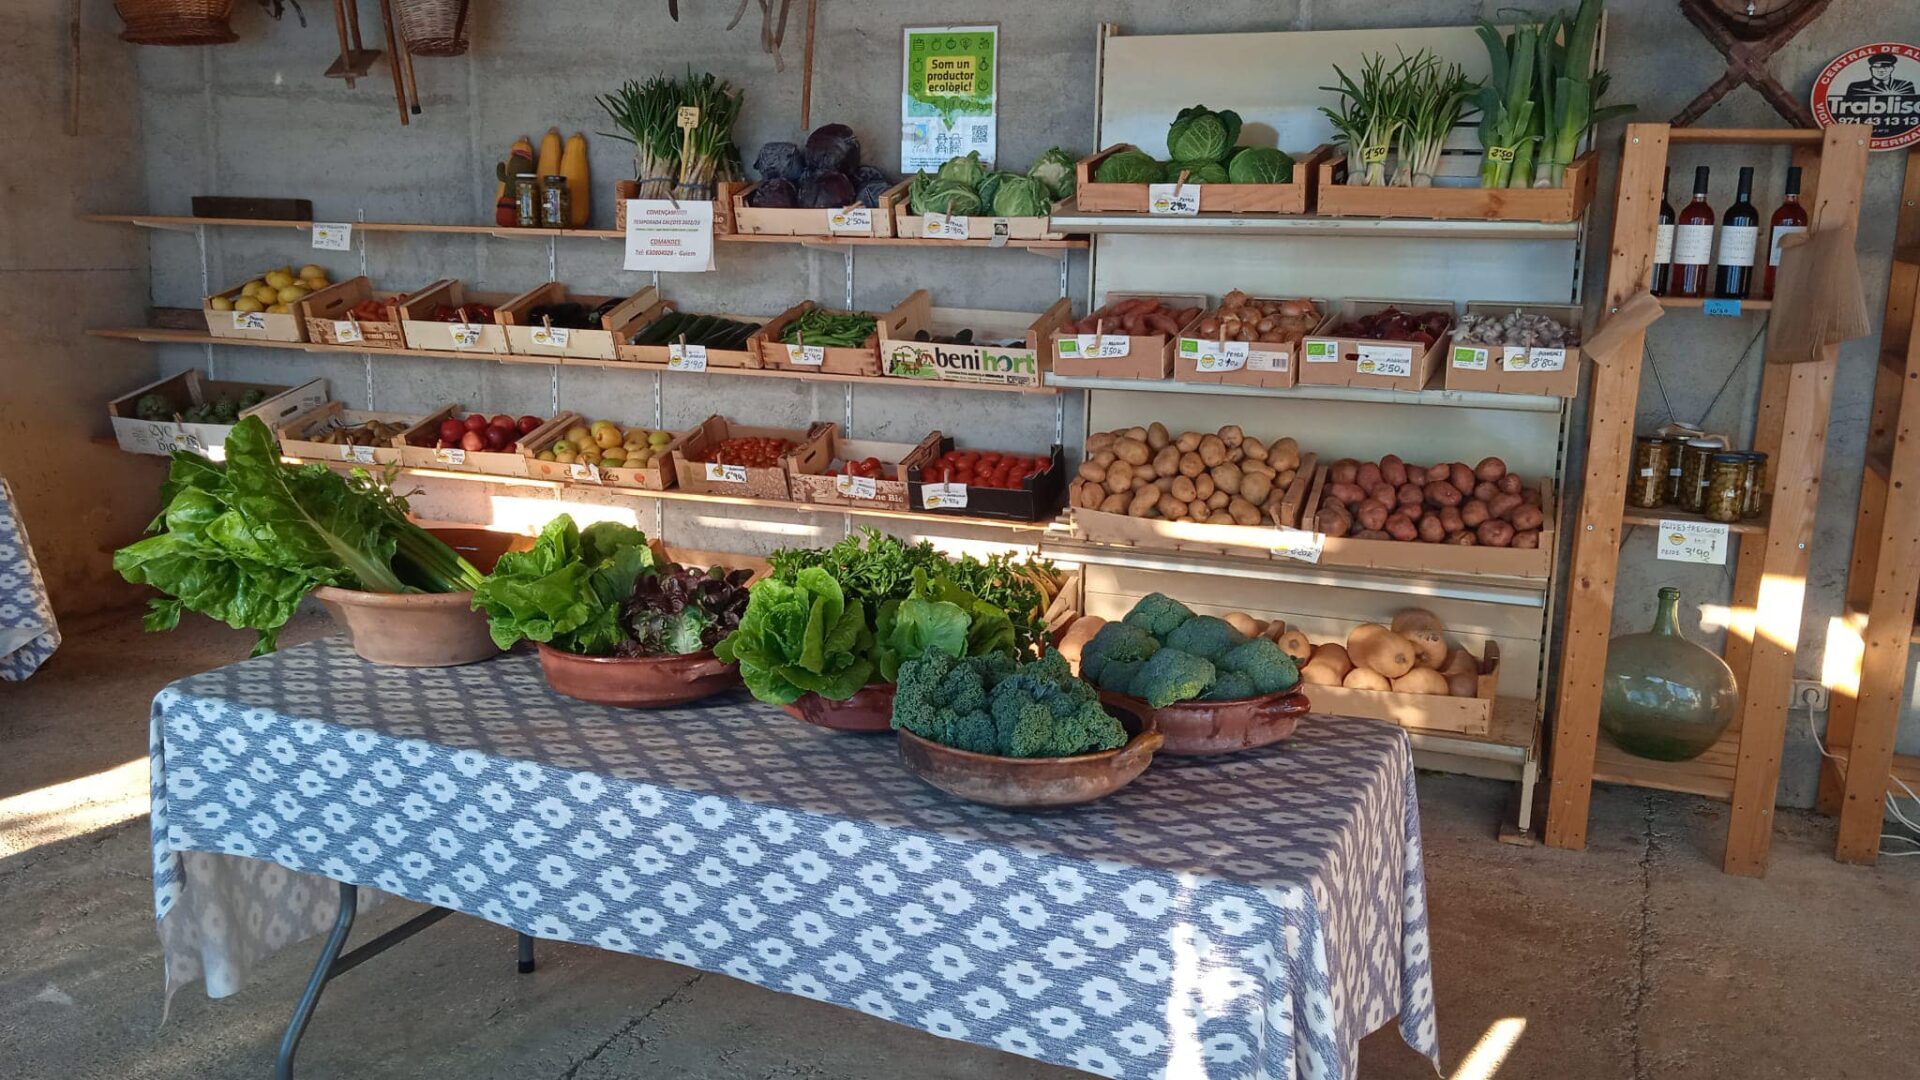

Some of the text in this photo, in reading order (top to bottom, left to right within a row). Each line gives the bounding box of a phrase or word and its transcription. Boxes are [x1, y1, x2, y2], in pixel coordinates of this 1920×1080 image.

[932, 59, 970, 69] Som un
[1821, 47, 1876, 84] CENTRAL
[927, 71, 974, 83] productor
[928, 82, 972, 94] ecològic!
[1838, 117, 1919, 126] 971 43 13 13
